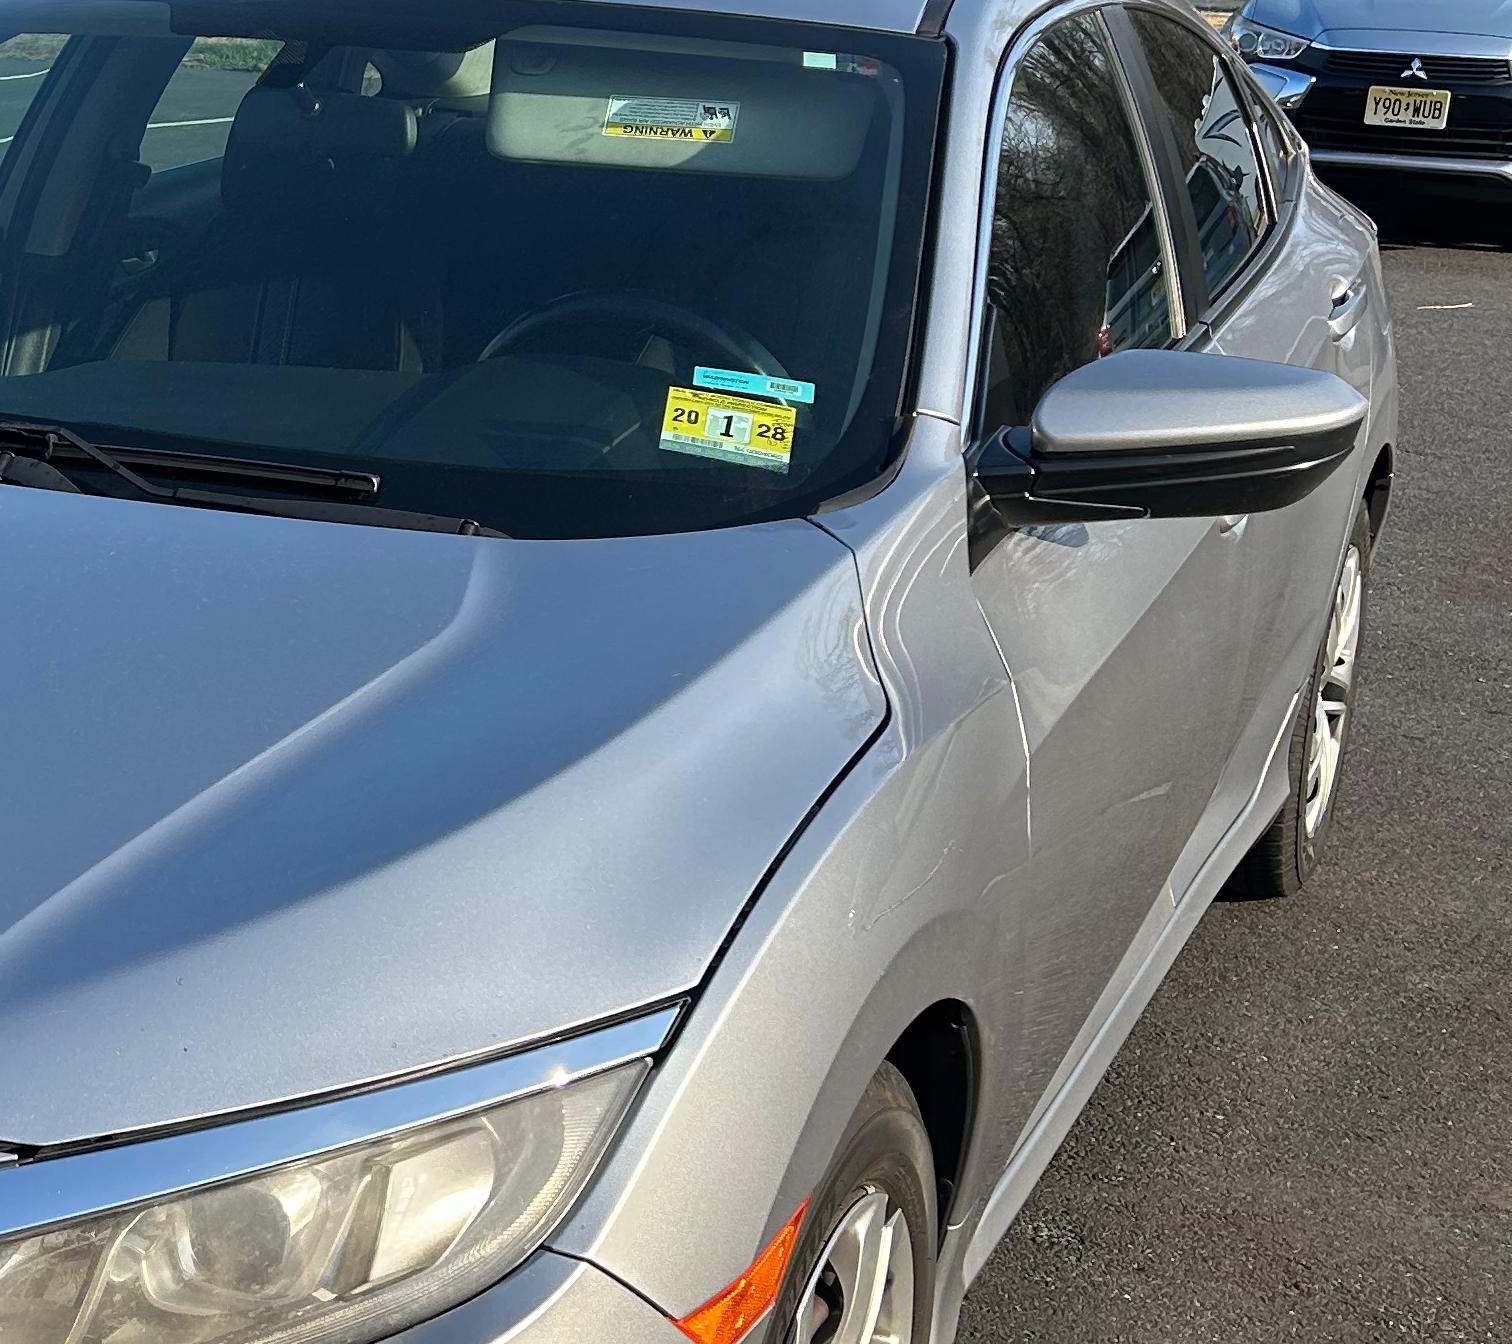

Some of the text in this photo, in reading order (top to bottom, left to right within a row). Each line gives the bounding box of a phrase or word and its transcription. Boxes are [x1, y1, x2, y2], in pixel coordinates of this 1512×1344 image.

[1373, 96, 1443, 120] Y90 WUB
[622, 124, 694, 138] WARNING
[672, 407, 699, 425] 20
[720, 415, 734, 438] 1
[756, 423, 786, 441] 28
